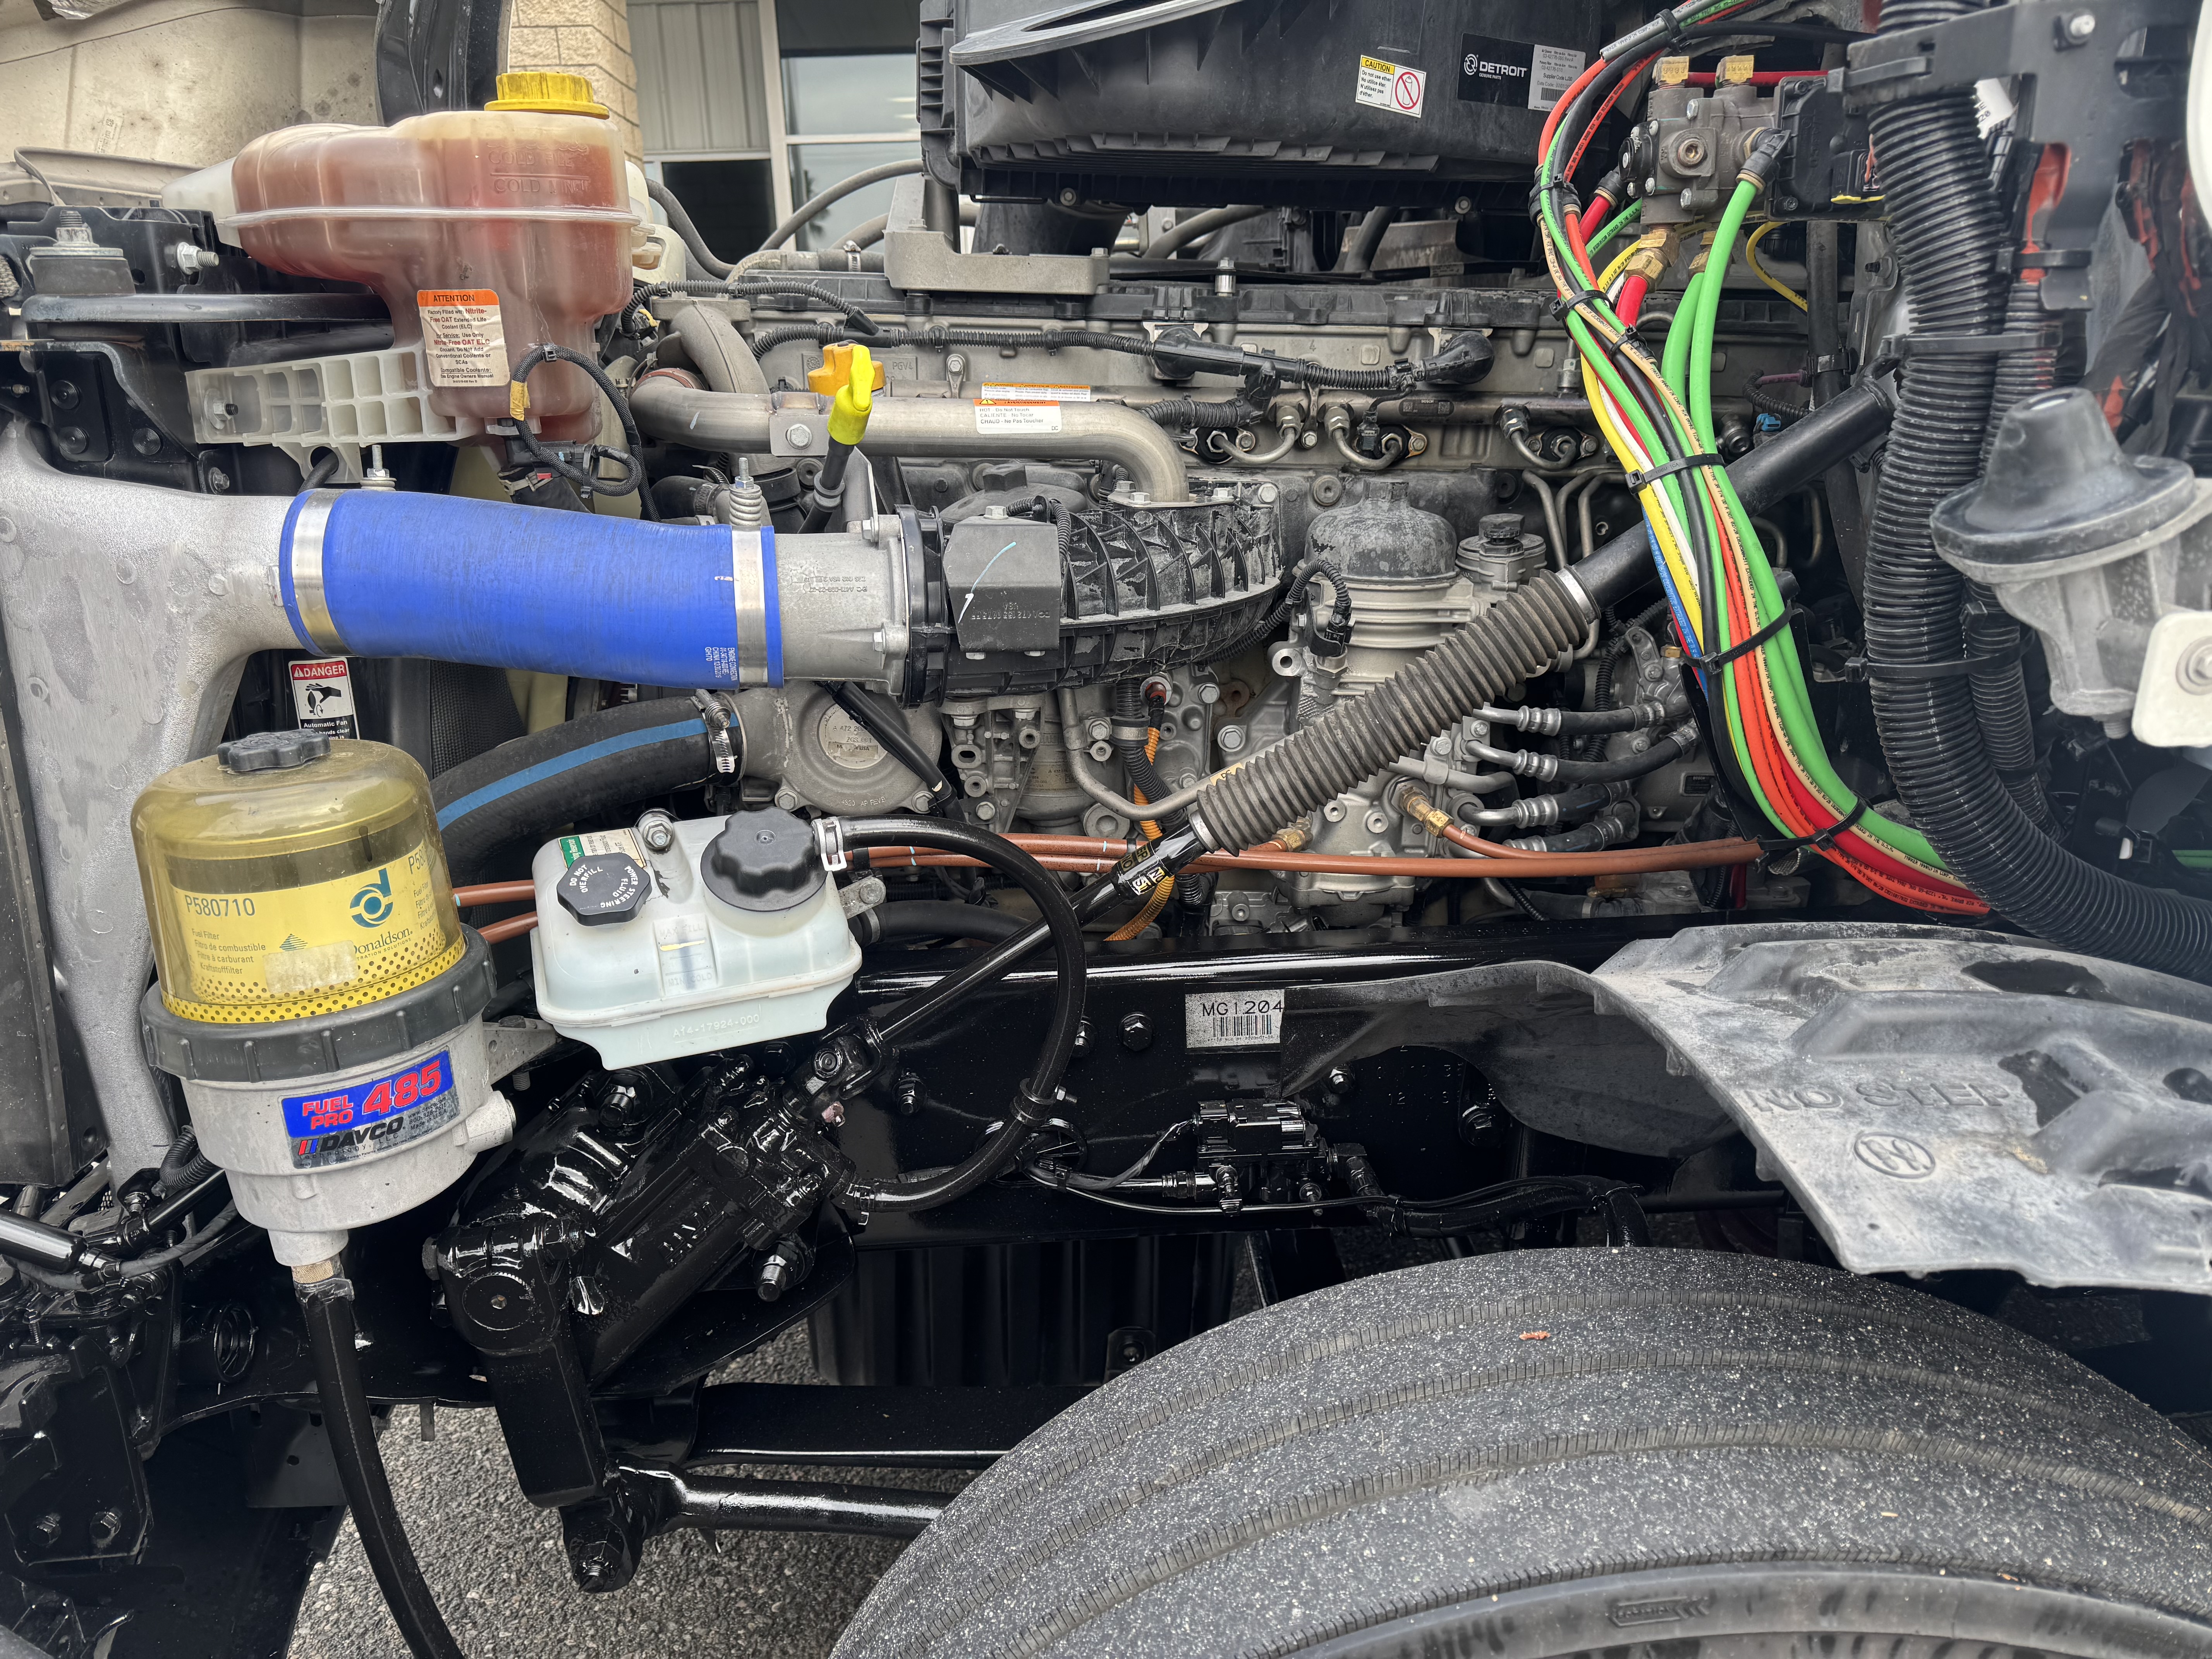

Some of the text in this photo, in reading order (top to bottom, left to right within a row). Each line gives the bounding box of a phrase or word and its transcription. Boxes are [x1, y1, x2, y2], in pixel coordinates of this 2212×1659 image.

[1365, 60, 1390, 72] CAUTION
[1479, 61, 1527, 77] DETROIT
[488, 151, 535, 165] COLD
[494, 179, 540, 192] COLD
[1744, 568, 1755, 591] EXTRUDED
[728, 647, 736, 662] ENGINE
[304, 665, 345, 677] DANGER
[566, 838, 579, 853] Reservoir
[1881, 841, 1894, 853] U.S.A.
[570, 864, 587, 886] DO NOT
[579, 866, 603, 893] OVERFILL
[1149, 868, 1164, 883] NO
[600, 866, 638, 908] POWER STEERING
[612, 878, 628, 897] FLUID
[184, 894, 256, 917] P580710
[191, 928, 220, 940] Fuel Filter
[659, 923, 704, 936] MAX FILL
[195, 940, 266, 951] Filtro de combustible
[356, 938, 411, 961] TRATION SOLUTIONS
[197, 950, 254, 963] Filtre à carburant
[200, 962, 242, 974] Kraftstofffilter
[668, 972, 713, 987] MIN COLD
[1202, 1000, 1283, 1016] MG1204
[673, 1014, 759, 1038] A14-17924-000
[362, 1060, 441, 1116] 485
[1744, 1082, 2010, 1112] NO STEP
[302, 1095, 354, 1116] FUEL
[408, 1097, 446, 1119] www.davco.com
[409, 1103, 446, 1124] 800-328-2611
[311, 1109, 353, 1130] PRO
[410, 1121, 425, 1131] Made
[434, 1109, 448, 1120] U.S.A.
[320, 1116, 404, 1152] DAVCO
[379, 1133, 399, 1144] LLC
